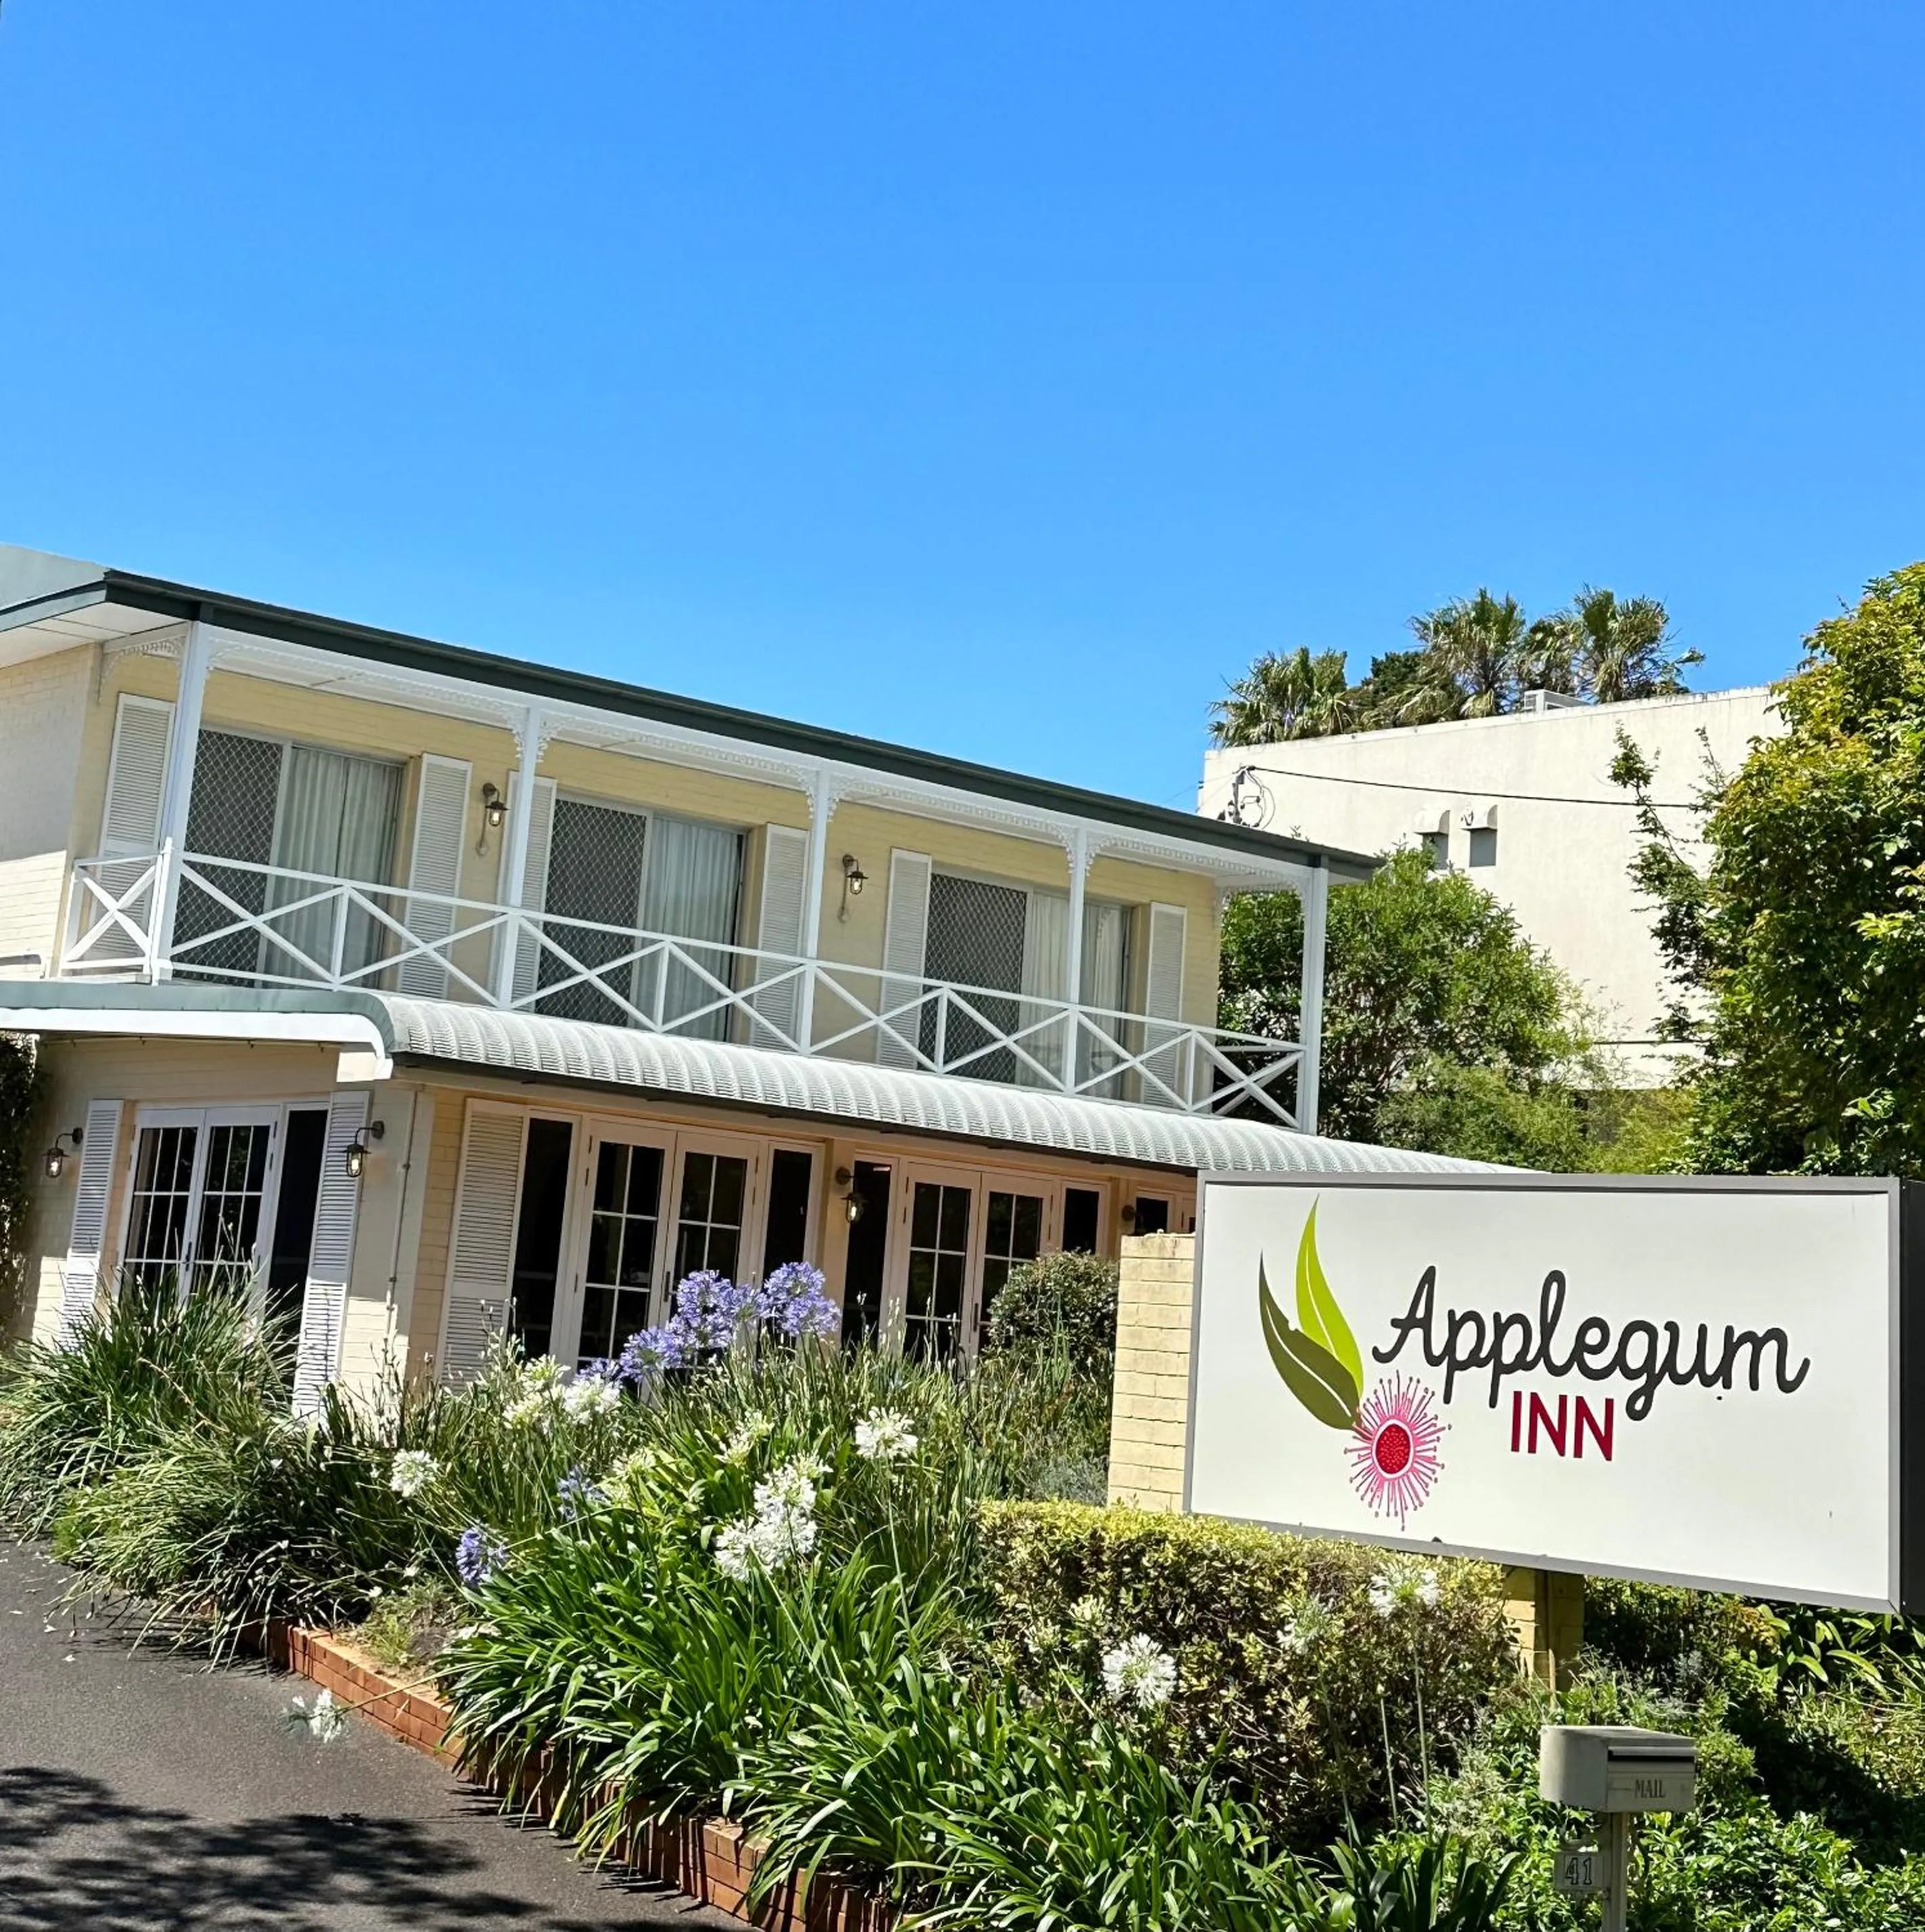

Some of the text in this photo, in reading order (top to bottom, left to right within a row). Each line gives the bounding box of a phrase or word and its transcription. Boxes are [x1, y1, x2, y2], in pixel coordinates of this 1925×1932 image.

[1372, 1265, 1810, 1421] Applegum
[1511, 1391, 1615, 1462] INN
[1634, 1779, 1665, 1798] MAIL
[1565, 1857, 1593, 1885] 41
